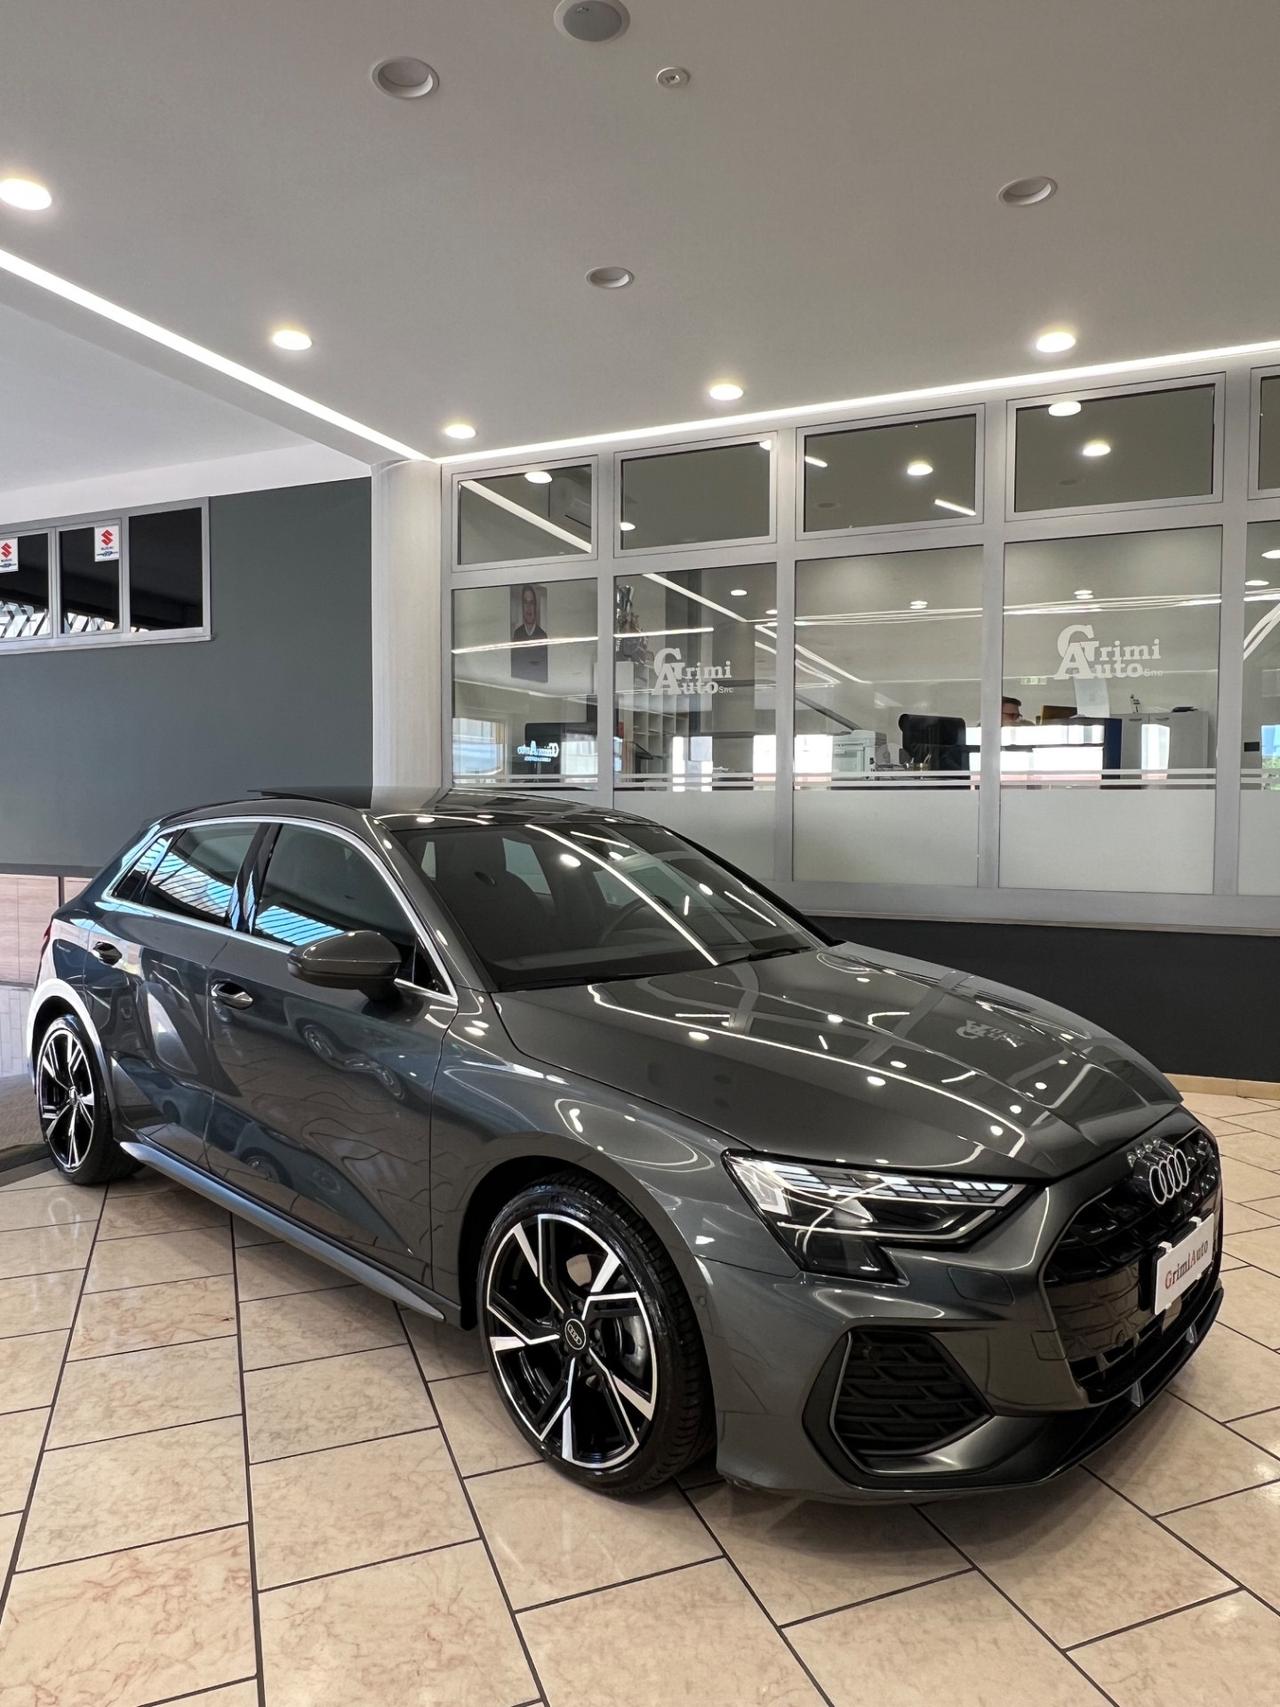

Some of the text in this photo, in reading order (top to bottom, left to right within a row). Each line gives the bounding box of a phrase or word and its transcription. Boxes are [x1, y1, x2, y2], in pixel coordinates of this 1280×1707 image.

[1057, 624, 1161, 661] Grimi
[654, 648, 732, 680] Grimi
[1054, 642, 1143, 680] Auto
[651, 663, 719, 695] Auto
